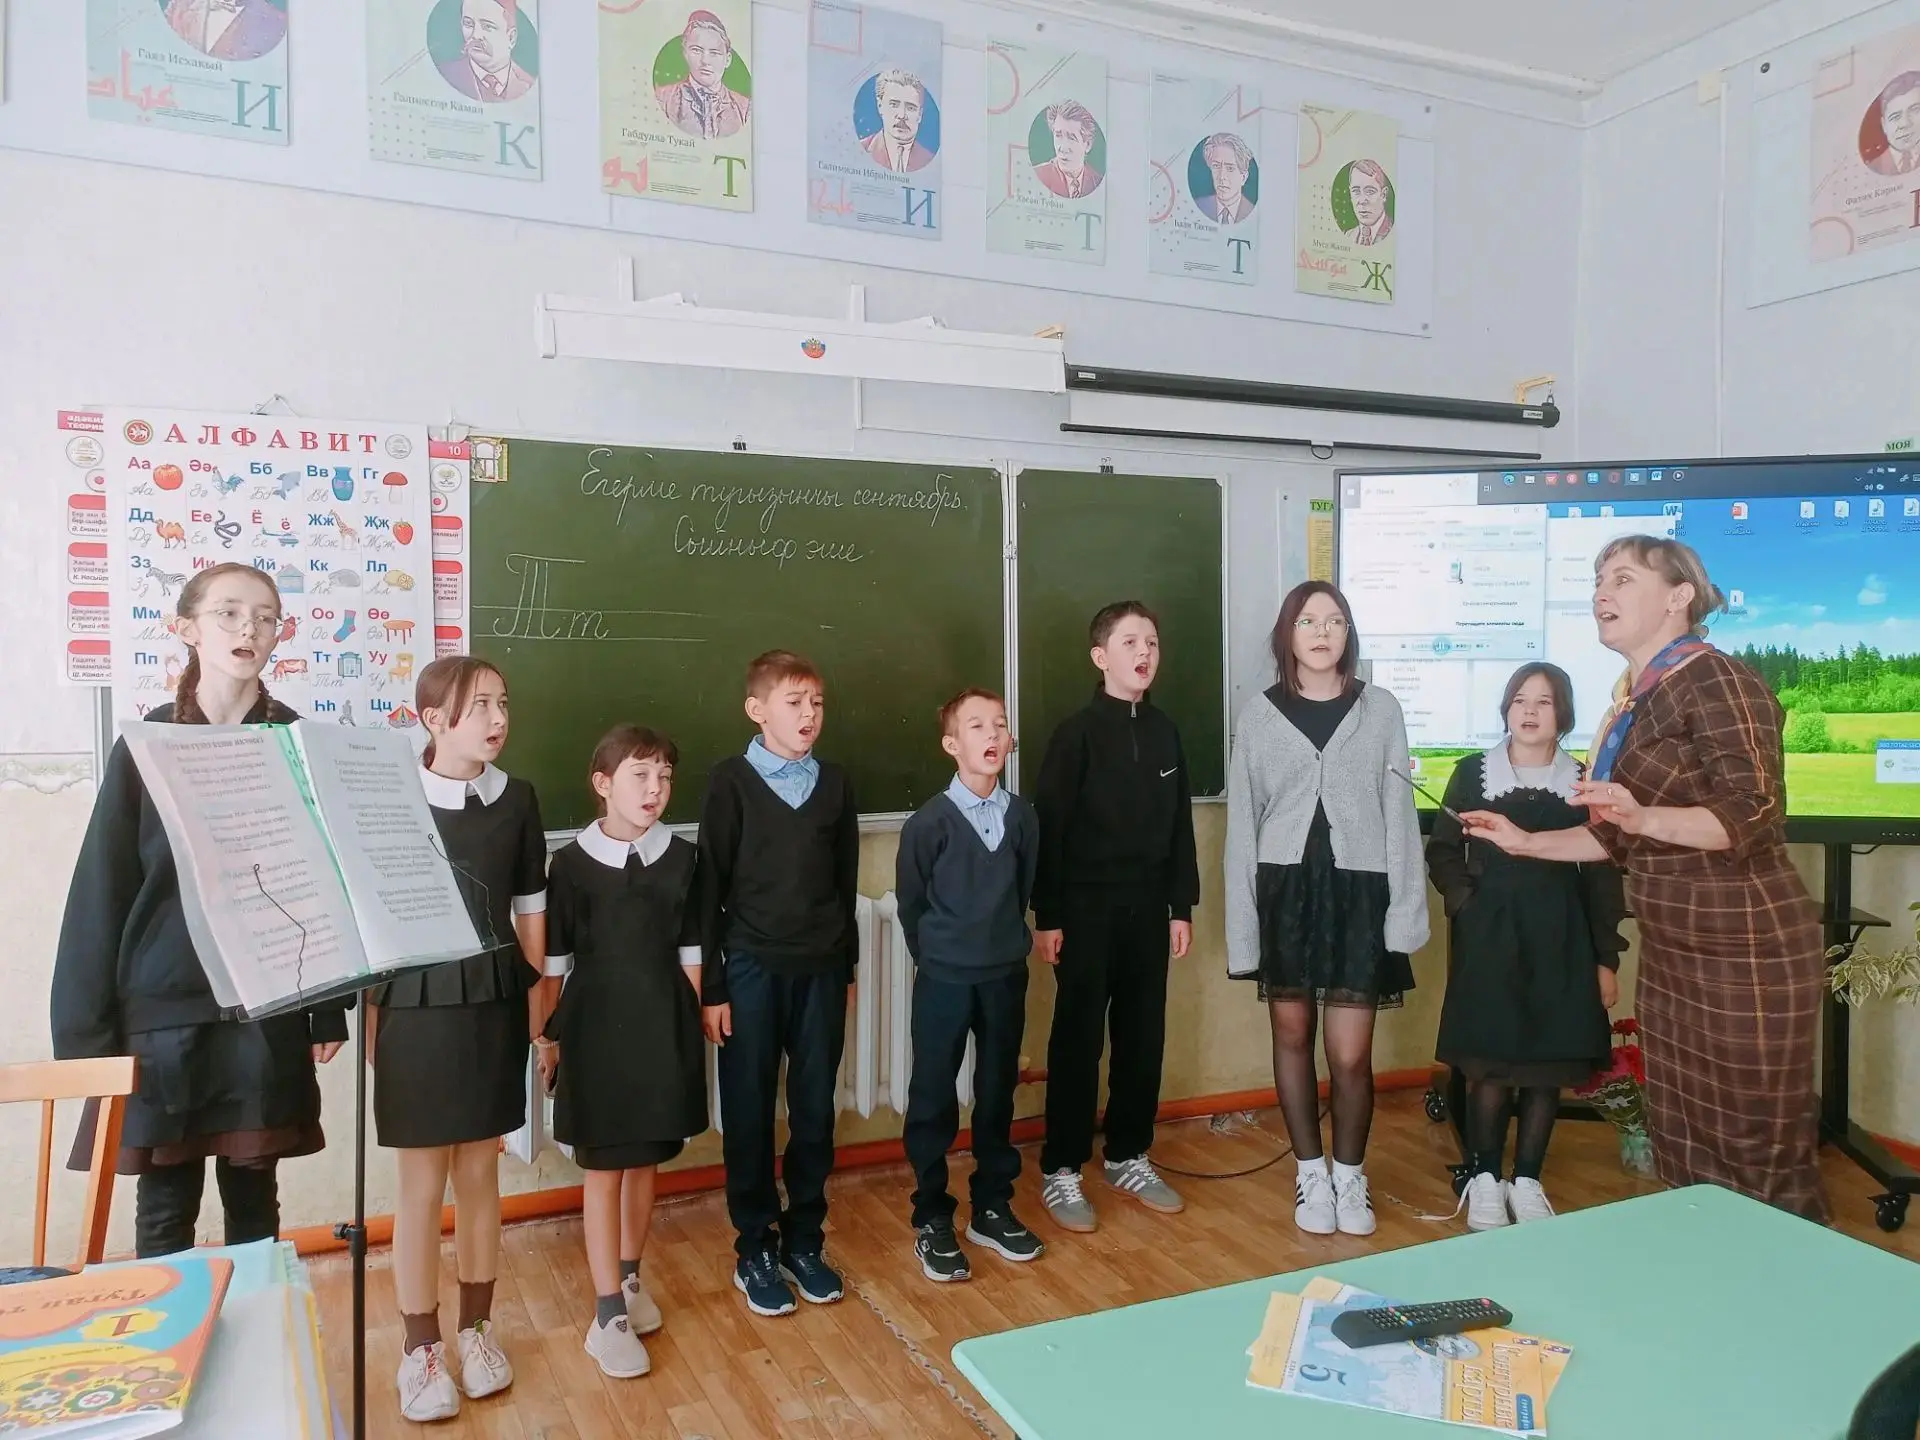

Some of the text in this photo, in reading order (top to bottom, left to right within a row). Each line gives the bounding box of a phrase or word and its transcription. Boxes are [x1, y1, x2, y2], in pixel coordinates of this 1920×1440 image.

[231, 78, 282, 131] И
[450, 101, 484, 116] Камал
[493, 121, 538, 169] К
[621, 128, 696, 148] Габдулла Тукай
[713, 155, 746, 197] Т
[902, 186, 936, 228] И
[1075, 211, 1101, 250] Т
[1227, 237, 1251, 275] Т
[164, 422, 377, 453] АЛФАВИТ
[1886, 440, 1912, 451] МОЯ
[449, 446, 461, 456] 10
[128, 457, 379, 480] Аа Әә Бб Вв Гг
[580, 447, 681, 526] Егерме
[128, 508, 154, 523] Дд
[191, 509, 212, 523] Ее
[308, 513, 334, 527] Жж
[805, 539, 864, 562] эше
[131, 555, 388, 572] Зз Ии Йй Кк Лл
[132, 606, 390, 620] Мм Оо Өө
[135, 652, 158, 665] Пп
[312, 651, 331, 663] Тт
[368, 650, 388, 665] Уу
[370, 699, 393, 712] Цц
[1300, 1363, 1347, 1387] 5
[1452, 1363, 1483, 1423] карты
